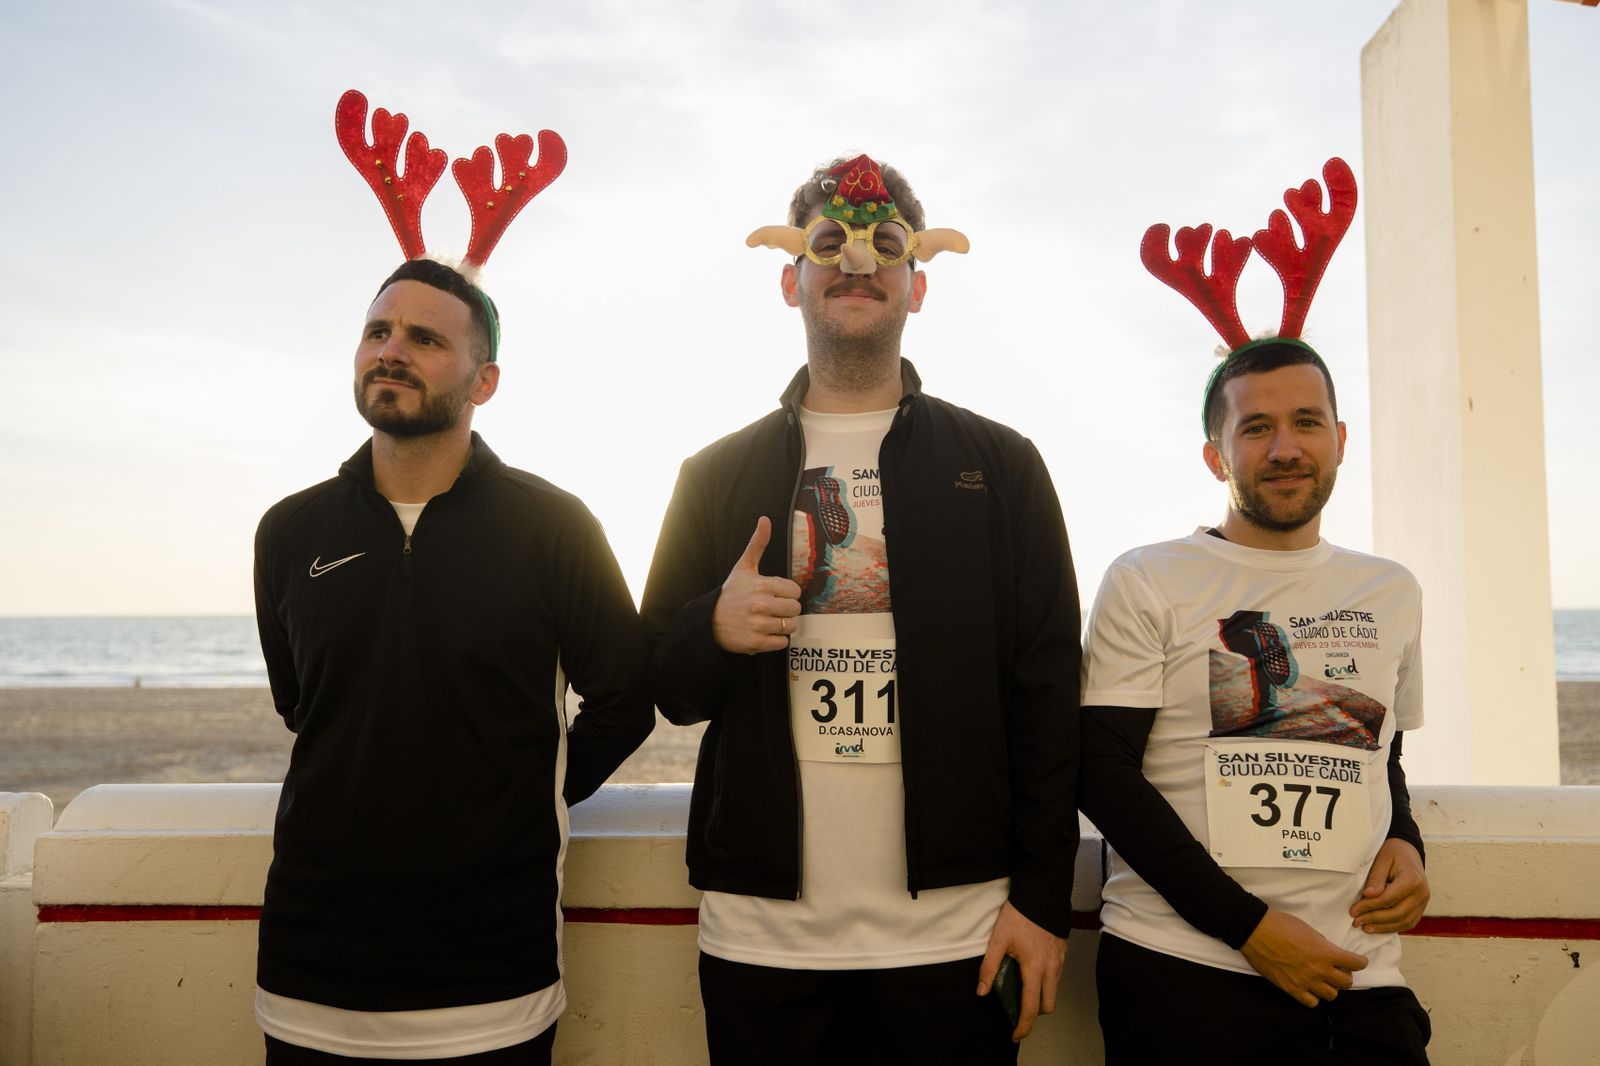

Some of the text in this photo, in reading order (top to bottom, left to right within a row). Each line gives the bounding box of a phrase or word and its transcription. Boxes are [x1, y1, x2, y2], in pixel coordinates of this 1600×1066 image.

[852, 468, 879, 480] SAN
[852, 485, 882, 498] CIUD
[853, 499, 880, 508] JUEVES
[1289, 609, 1375, 628] SAN SILVESTRE
[1332, 626, 1347, 638] DE
[1349, 624, 1378, 640] CÁDIZ
[1320, 641, 1329, 649] 29
[1343, 640, 1380, 650] DICIEMBRE
[789, 647, 823, 658] SAN
[790, 658, 848, 673] CIUDAD
[853, 660, 876, 673] DE
[810, 678, 896, 724] 311
[818, 725, 894, 736] D.CASANOVA
[1217, 752, 1361, 771] SAN SILVESTRE
[1219, 763, 1288, 777] CIUDAD
[1293, 764, 1315, 778] DE
[1249, 782, 1341, 830] 377
[1281, 829, 1322, 841] PABLO
